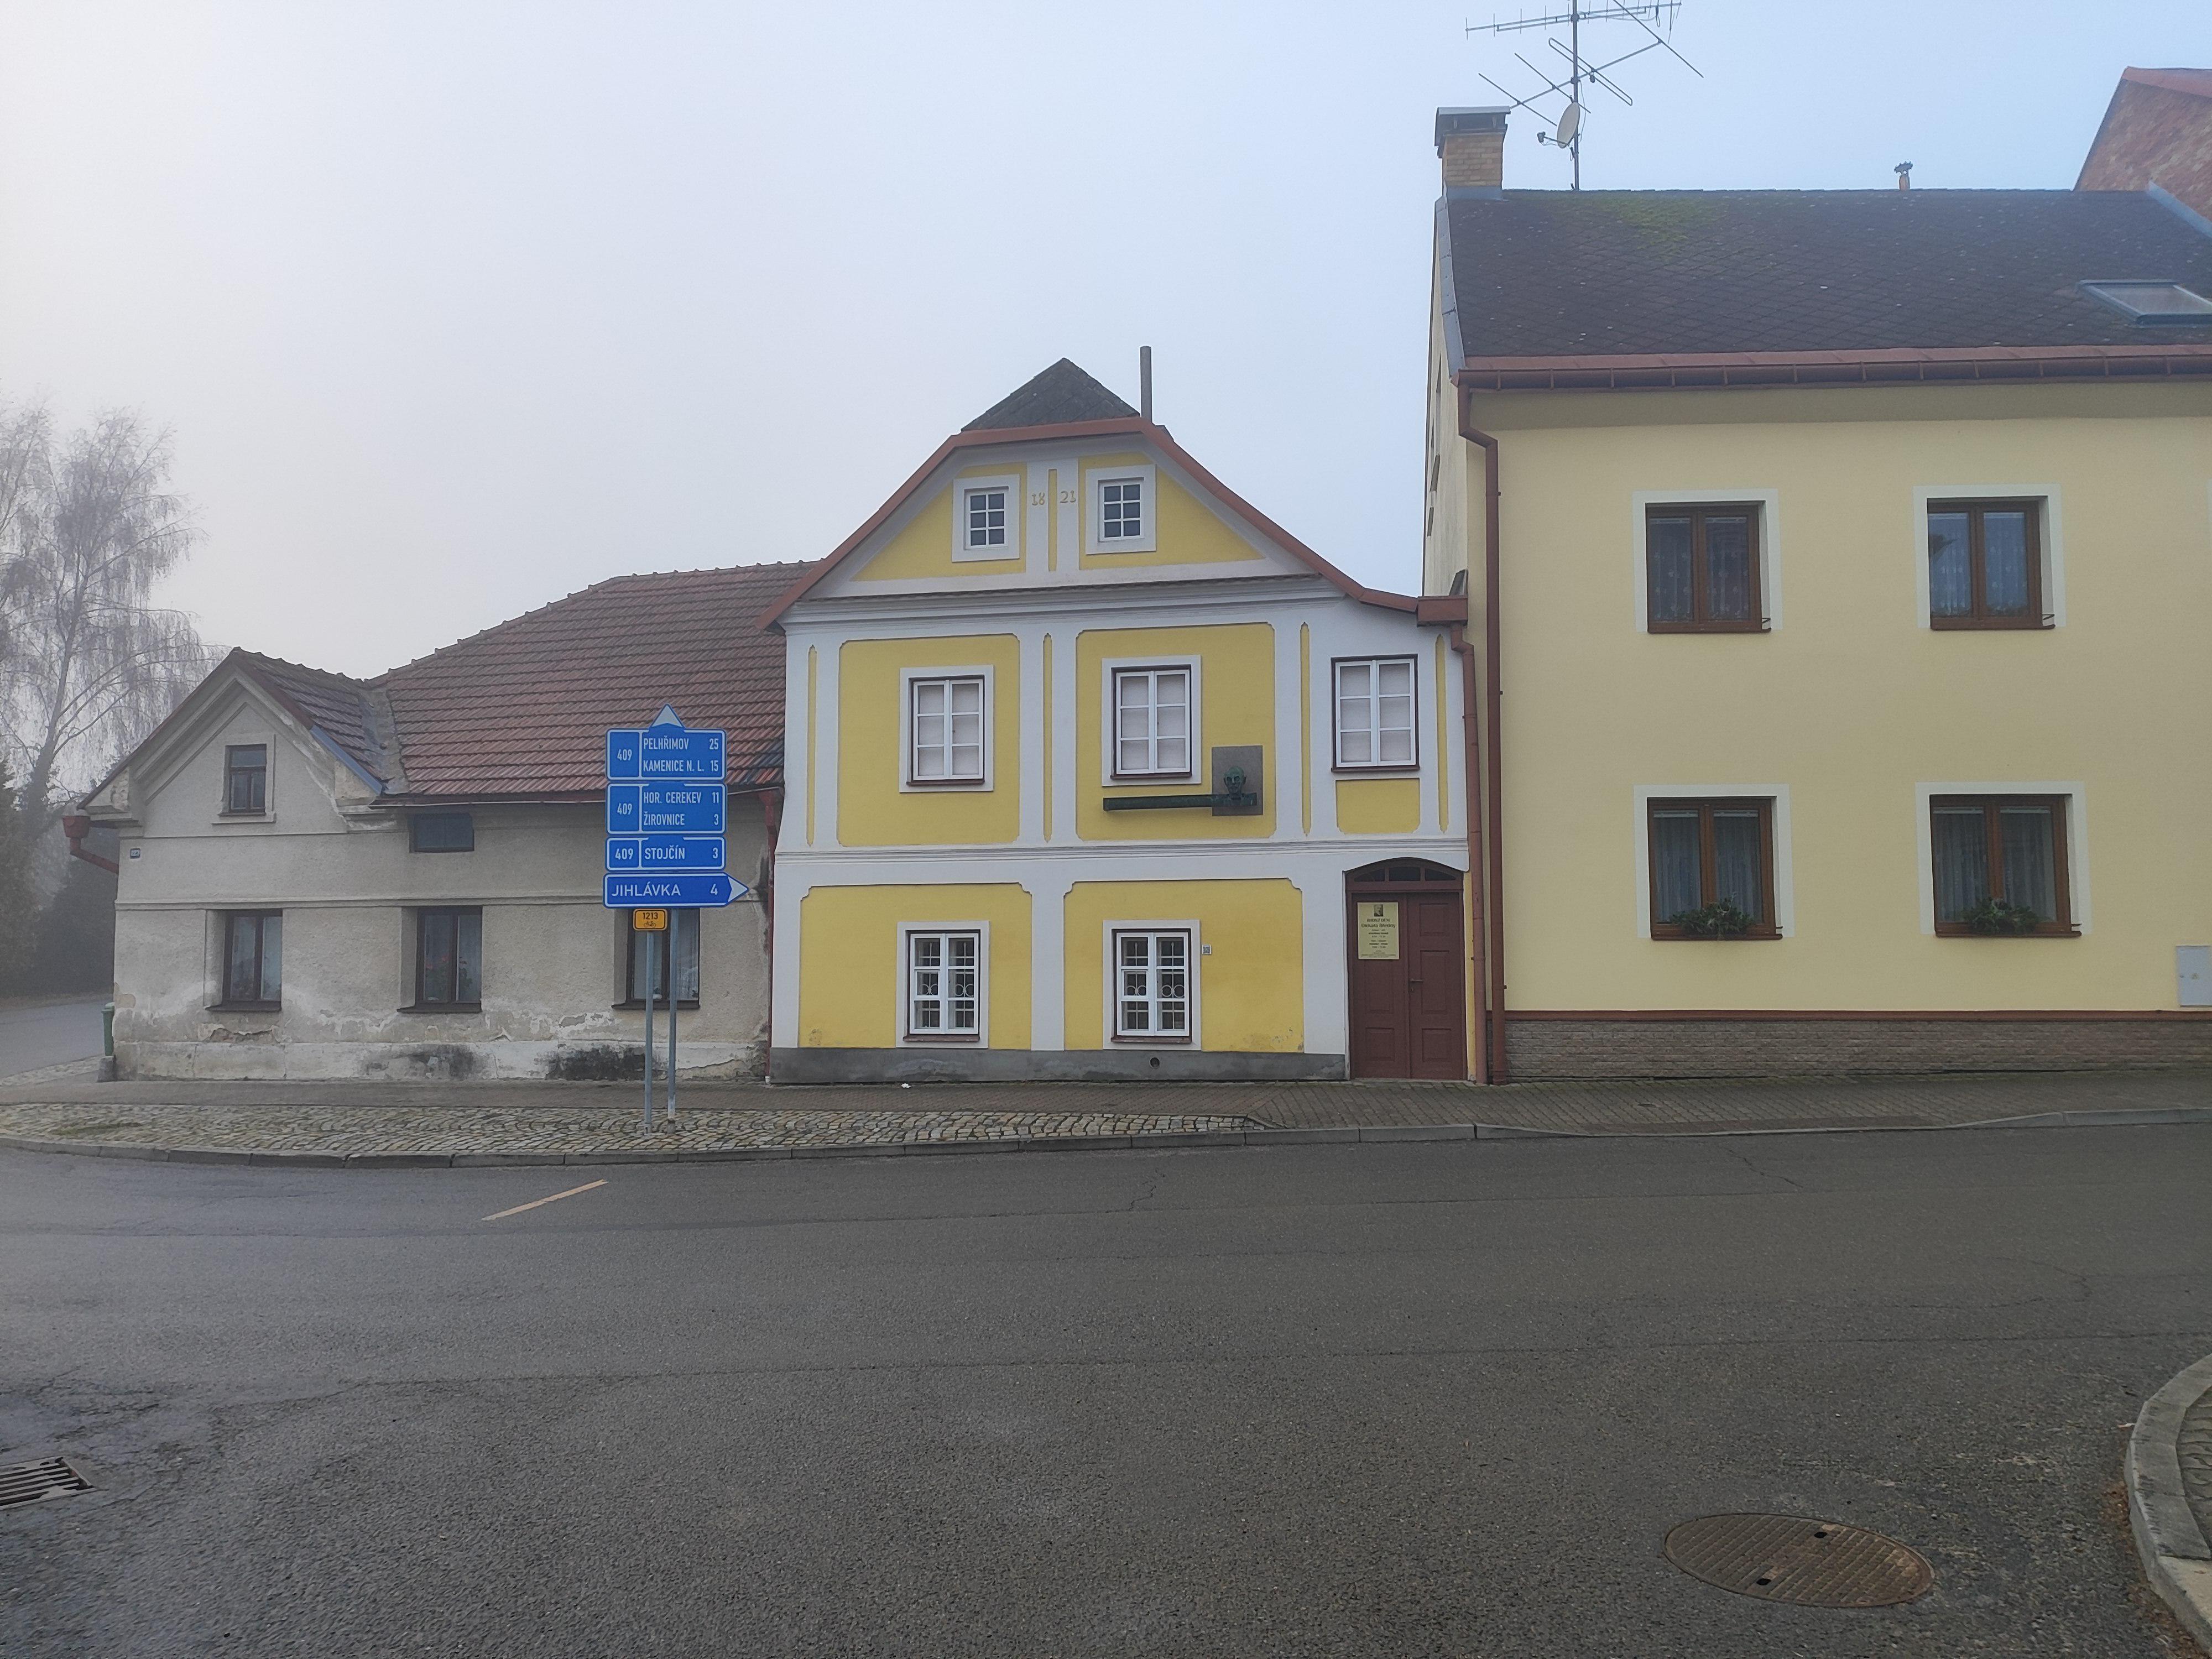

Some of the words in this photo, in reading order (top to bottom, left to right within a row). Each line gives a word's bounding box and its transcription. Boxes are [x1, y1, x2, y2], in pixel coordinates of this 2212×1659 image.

[1032, 492, 1045, 505] 18
[1060, 490, 1076, 503] 21
[643, 735, 689, 750] PELHŘIMOV
[709, 738, 719, 750] 25
[617, 749, 632, 761] 409
[643, 760, 684, 772] KAMENICE
[686, 760, 695, 772] N.
[697, 760, 705, 772] L.
[710, 760, 719, 771] 15
[643, 791, 662, 804] HOR.
[666, 791, 702, 804] CEREKEV
[712, 791, 719, 804] 11
[617, 803, 633, 815] 409
[643, 810, 685, 826] ŽIROVNICE
[713, 813, 719, 826] 3
[615, 848, 634, 860] 409
[644, 844, 685, 859] STOJČÍN
[712, 847, 718, 859] 3
[612, 881, 681, 896] JIHLÁVKA
[710, 884, 718, 895] 4
